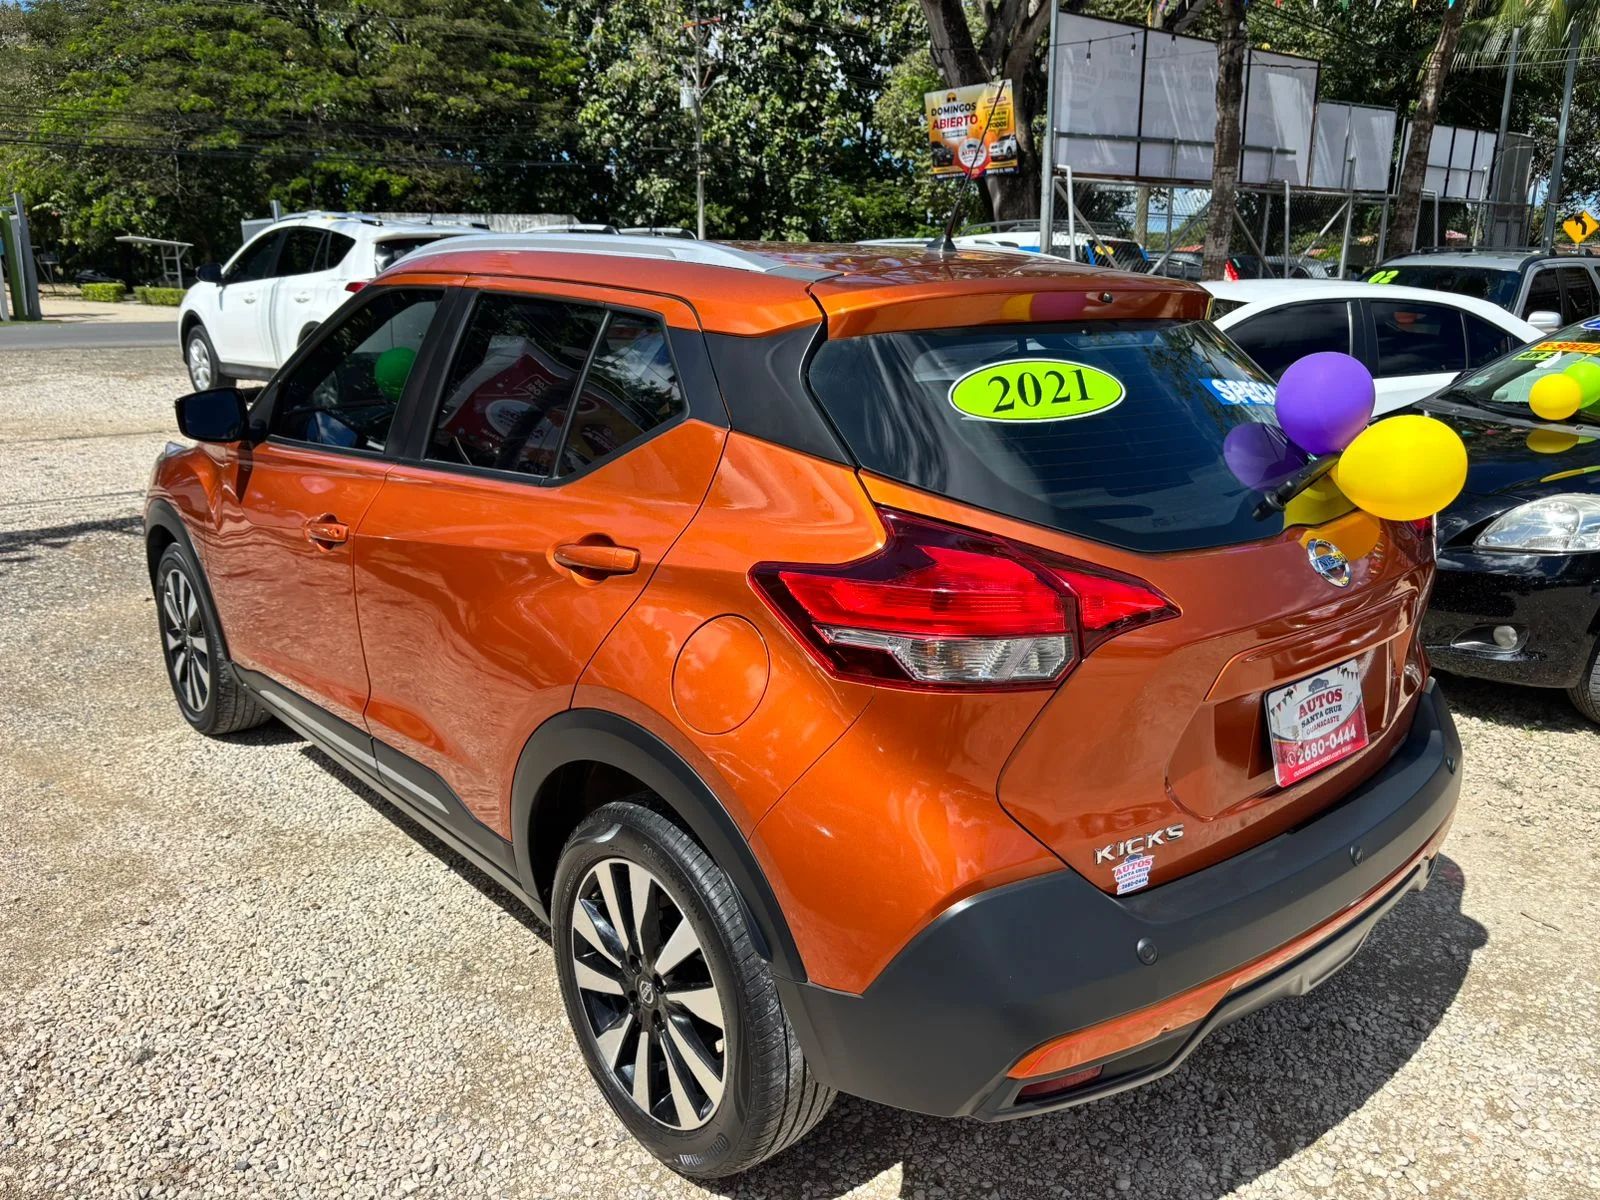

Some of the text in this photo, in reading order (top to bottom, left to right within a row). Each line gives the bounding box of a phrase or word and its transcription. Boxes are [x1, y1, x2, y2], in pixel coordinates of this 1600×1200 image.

[931, 102, 977, 117] DOMINGOS
[932, 114, 978, 130] ABIERTO
[987, 369, 1095, 413] 2021
[1298, 688, 1343, 719] AUTOS
[1301, 704, 1343, 728] SANTA CRUZ
[1306, 715, 1340, 735] GUANACASTE
[1297, 724, 1357, 765] 2680-0444
[1095, 824, 1184, 864] KICKS
[1116, 860, 1151, 876] AUTOS
[1117, 870, 1135, 880] SANTA
